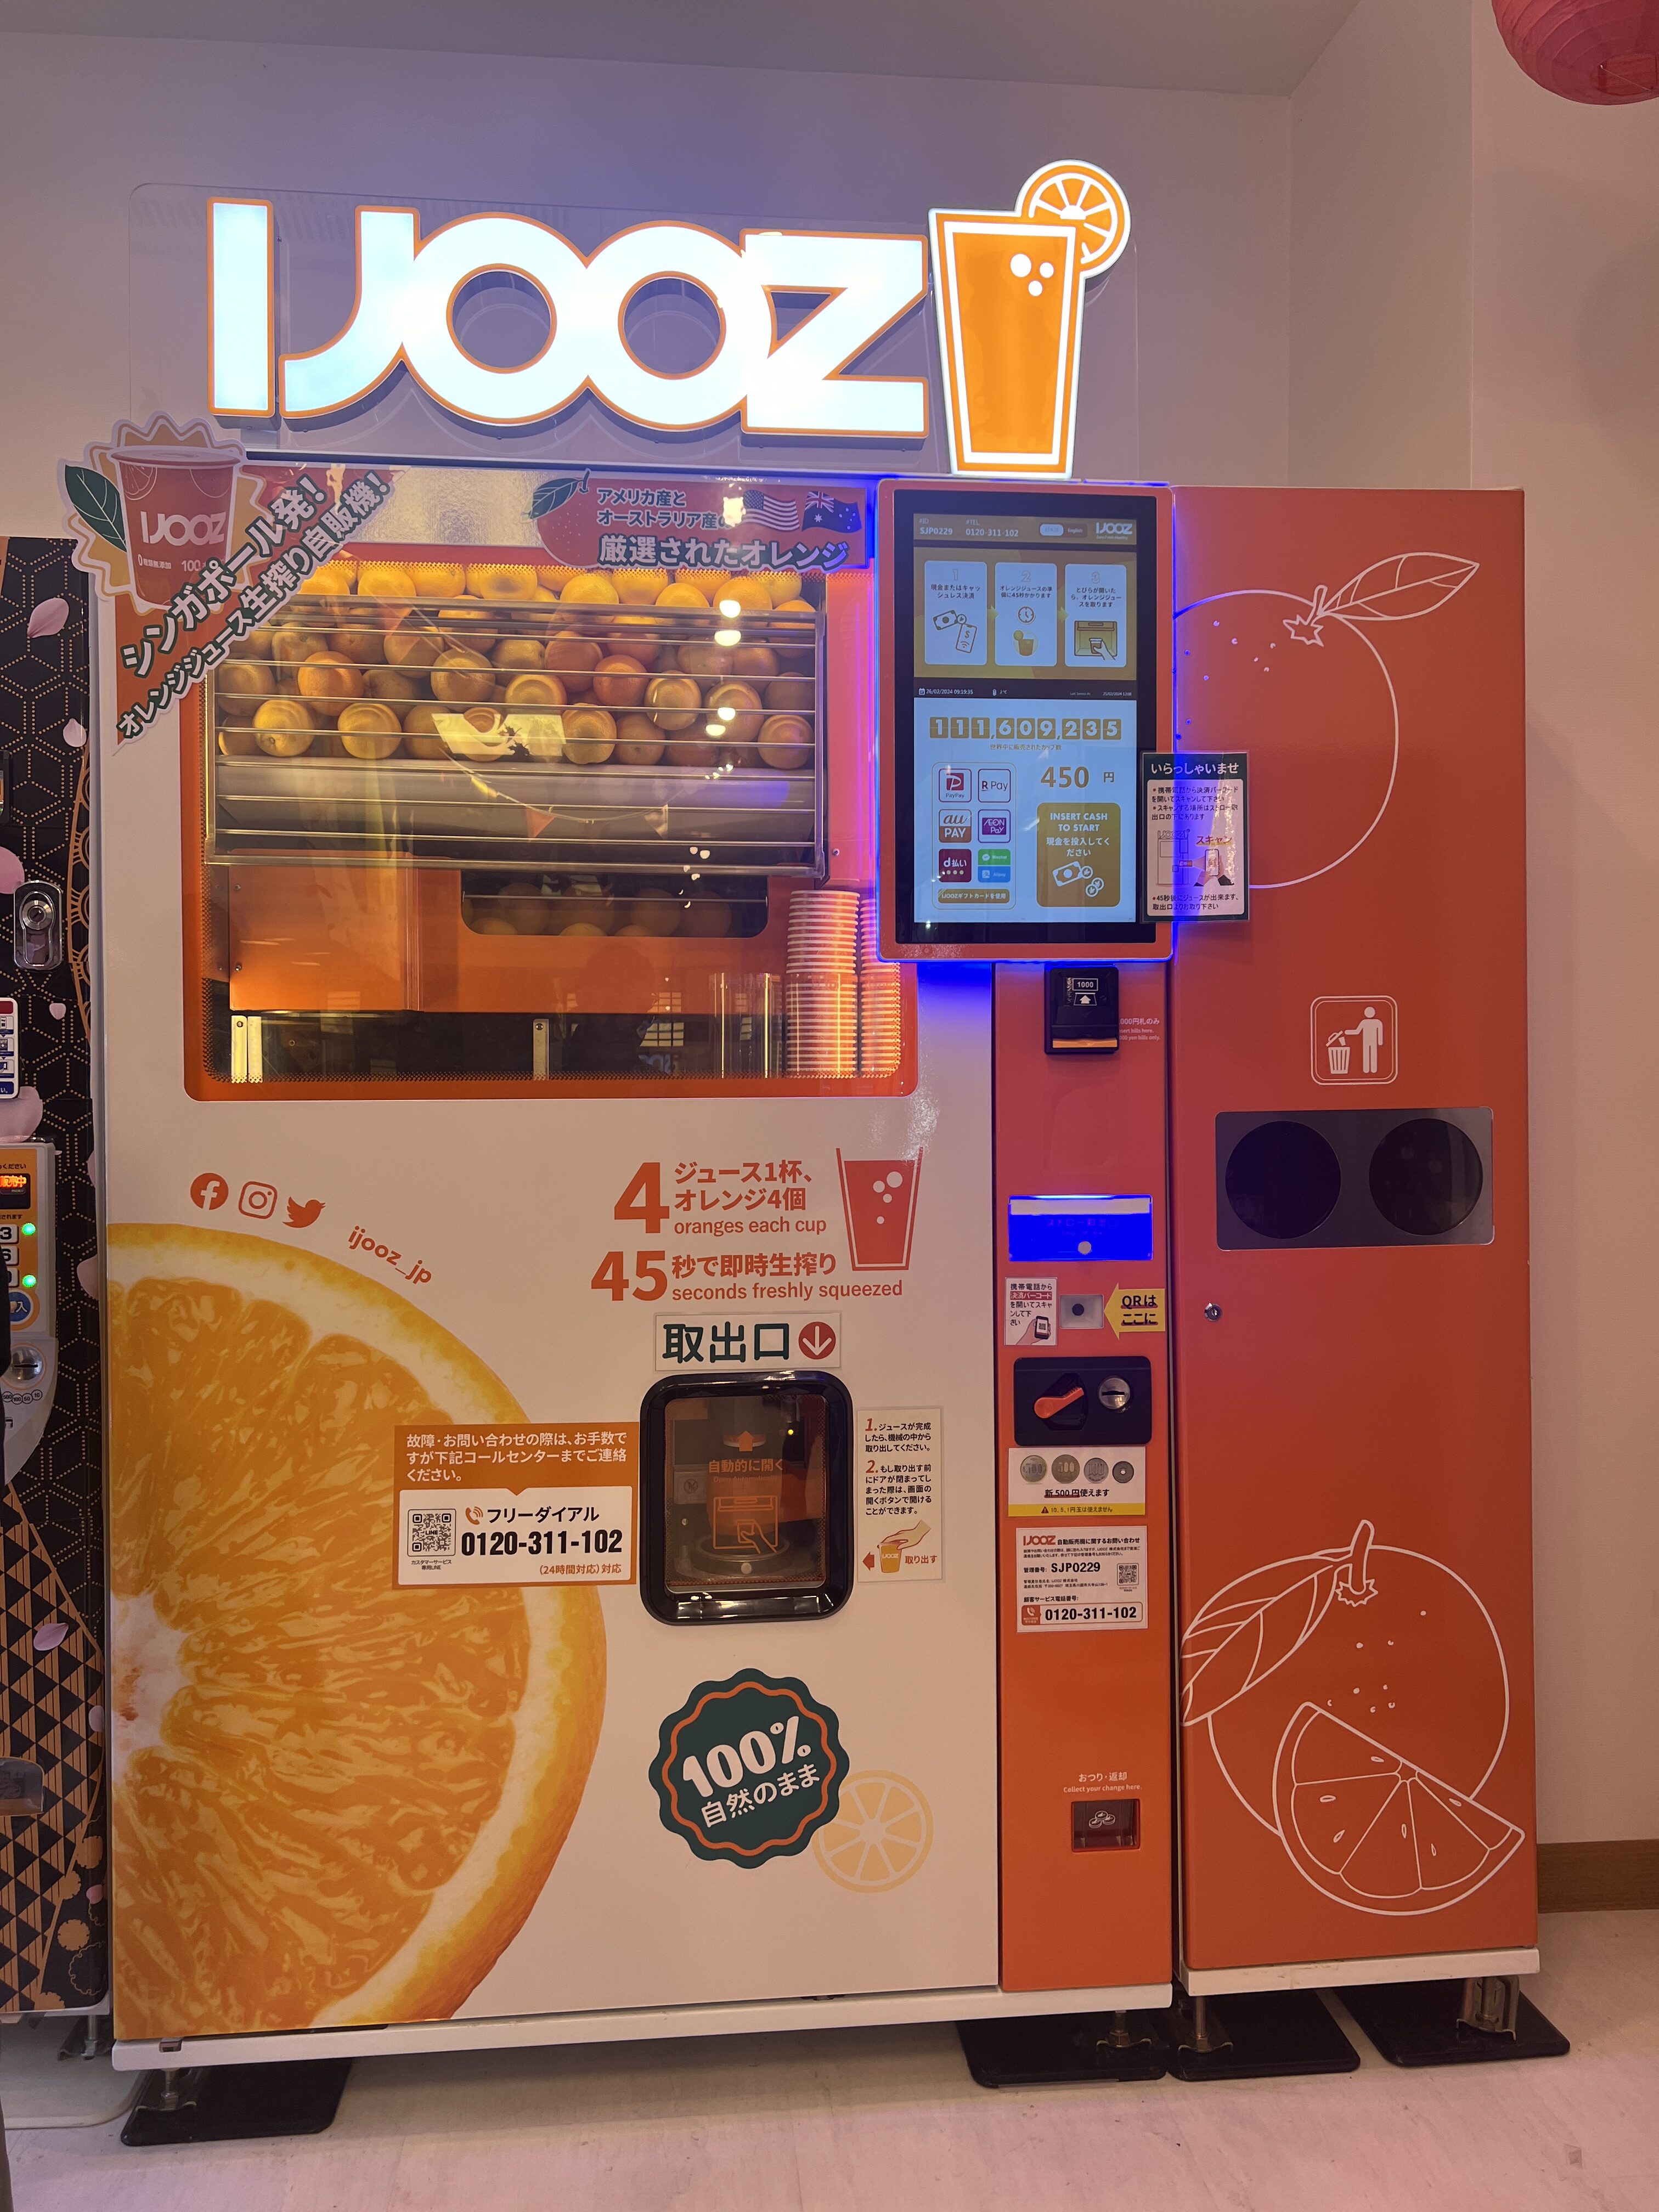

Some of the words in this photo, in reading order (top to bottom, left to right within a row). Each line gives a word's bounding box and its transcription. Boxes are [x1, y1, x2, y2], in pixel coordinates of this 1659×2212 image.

[597, 487, 687, 508] アメリカ産と
[919, 527, 953, 535] SJP0229
[598, 534, 849, 569] 厳選されたオレンジ
[182, 560, 206, 572] 100
[1151, 762, 1239, 775] いらっしゃいませ
[1041, 766, 1089, 788] 450
[1104, 772, 1114, 783] 円
[991, 781, 1008, 792] Pay
[944, 827, 966, 838] PAY
[1046, 837, 1110, 846] 現金を投入してく
[1066, 849, 1091, 857] ださい
[943, 857, 967, 868] d払い
[674, 1159, 812, 1184] ジュース1杯、
[614, 1161, 670, 1234] 4
[674, 1187, 806, 1211] オレンジ4個
[674, 1218, 744, 1237] oranges
[748, 1216, 791, 1233] each
[795, 1218, 827, 1235] cup
[348, 1226, 432, 1284] ijooz_jp
[591, 1250, 668, 1302] 45
[672, 1252, 836, 1278] 秒で即時生搾り
[672, 1283, 747, 1301] seconds
[752, 1282, 813, 1301] freshly
[819, 1280, 902, 1300] squeezed
[1121, 1294, 1157, 1310] QRは
[1122, 1313, 1157, 1325] ここに
[662, 1321, 790, 1364] 取出口
[879, 1422, 932, 1431] ジュースが完成
[865, 1433, 932, 1442] したら、機械の中から
[865, 1444, 930, 1453] 取り出してください。
[406, 1448, 627, 1465] すが下記コールセンターまでご連絡
[709, 1458, 784, 1474] 自動的に開く
[880, 1464, 932, 1472] もし取り出す前
[406, 1468, 462, 1482] ください。
[865, 1475, 932, 1484] にドアが閉まってし
[865, 1485, 932, 1494] まった際は、画面の
[866, 1496, 932, 1505] 開くボタンで開ける
[487, 1506, 600, 1524] フリーダイアル
[866, 1506, 917, 1515] ことができます。
[461, 1529, 623, 1556] 0120-311-102
[905, 1555, 938, 1564] 取り出す
[1051, 1562, 1101, 1573] SJP0229
[1045, 1606, 1137, 1621] 0120-311-102
[683, 1716, 811, 1797] 100%
[702, 1764, 820, 1827] 自然のまま
